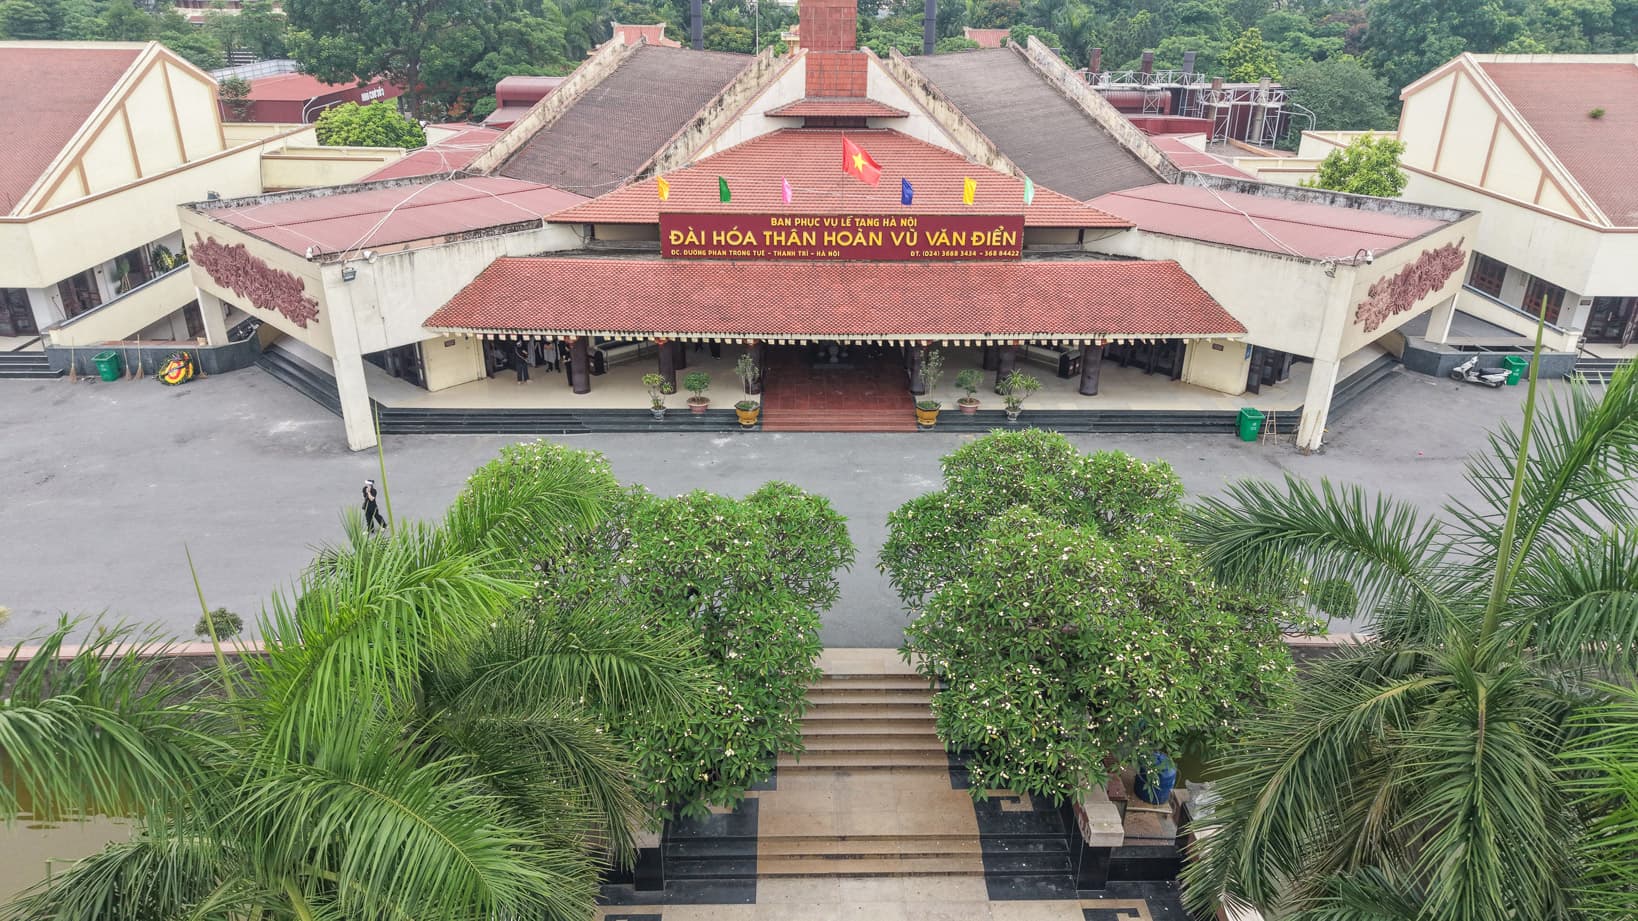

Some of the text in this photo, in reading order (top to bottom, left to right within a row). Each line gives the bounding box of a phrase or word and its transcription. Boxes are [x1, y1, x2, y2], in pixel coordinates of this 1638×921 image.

[771, 216, 917, 228] BAN PHỤC VỤ LỄ TANG HÀ NỘI
[669, 226, 706, 246] ĐÀI
[712, 225, 758, 246] HÓA
[763, 229, 817, 246] THÂN
[823, 228, 883, 246] HOÀN
[925, 228, 966, 246] VĂN
[971, 225, 1017, 246] ĐIỂN
